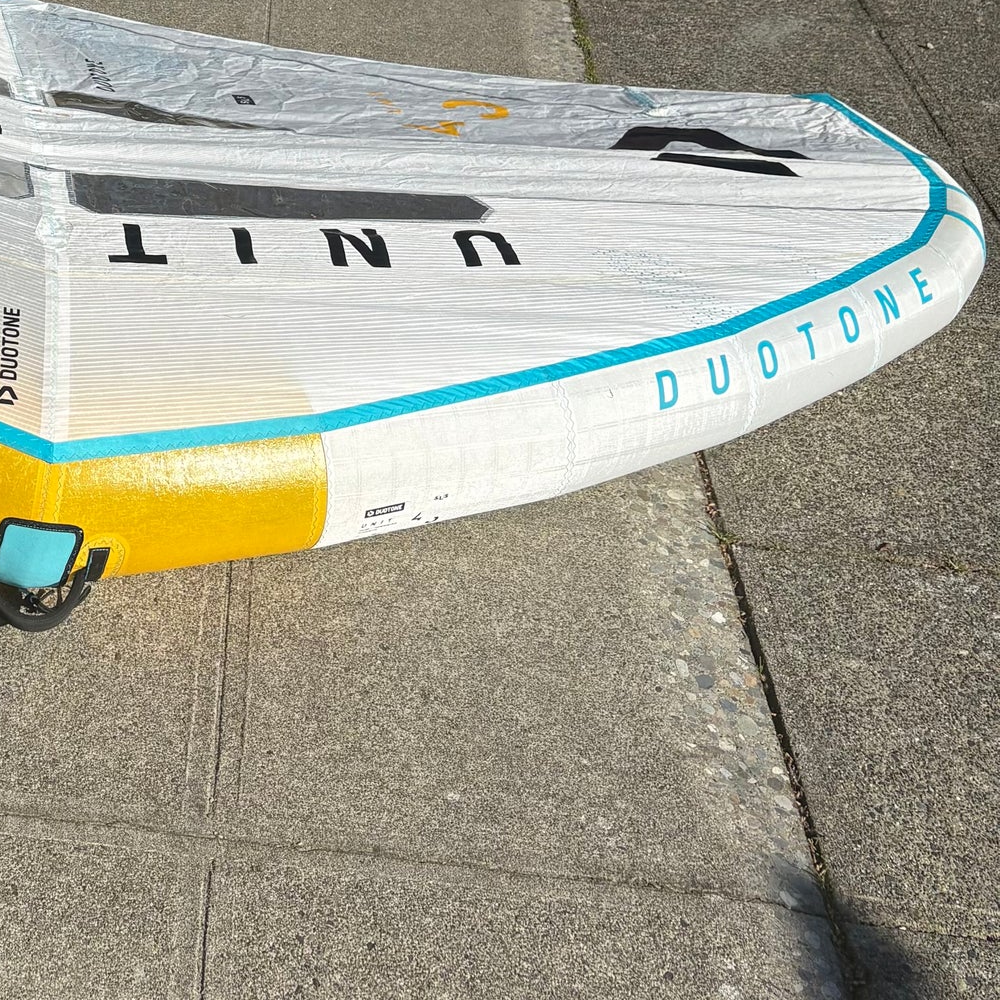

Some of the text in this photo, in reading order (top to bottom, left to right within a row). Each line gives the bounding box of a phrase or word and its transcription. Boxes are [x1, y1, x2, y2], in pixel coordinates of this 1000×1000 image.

[107, 222, 522, 268] UNIT
[0, 306, 21, 381] DUOTONE
[655, 266, 933, 411] DUOTONE
[374, 504, 404, 516] DUOTONE
